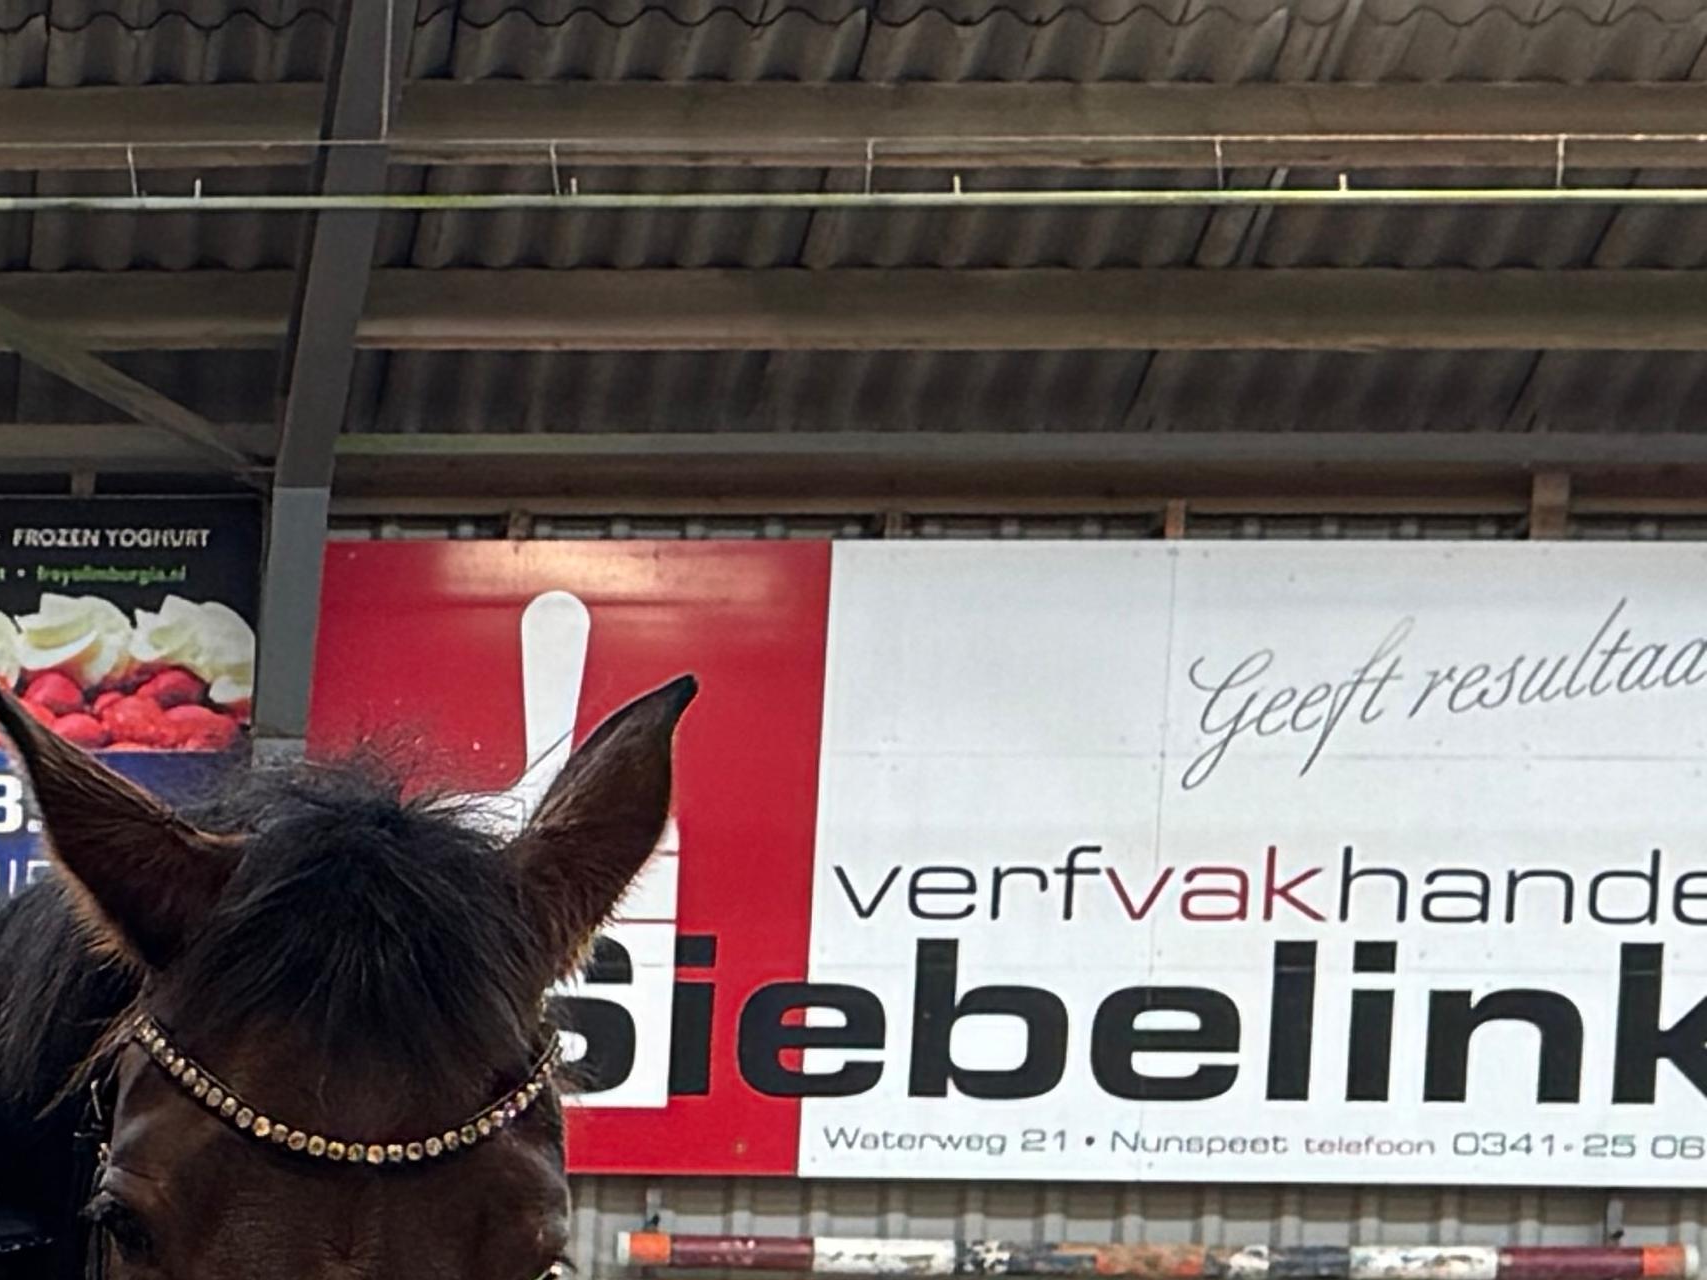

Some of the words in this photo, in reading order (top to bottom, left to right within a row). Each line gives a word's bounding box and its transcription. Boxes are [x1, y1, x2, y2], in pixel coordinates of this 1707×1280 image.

[11, 528, 99, 548] FROZEN
[106, 528, 212, 548] YOGHURT
[1181, 615, 1416, 790] Geeft
[822, 1125, 1008, 1156] Waterweg
[1021, 1128, 1067, 1152] 21
[1110, 1129, 1288, 1158] Nunspeet
[1303, 1135, 1436, 1156] telefoon
